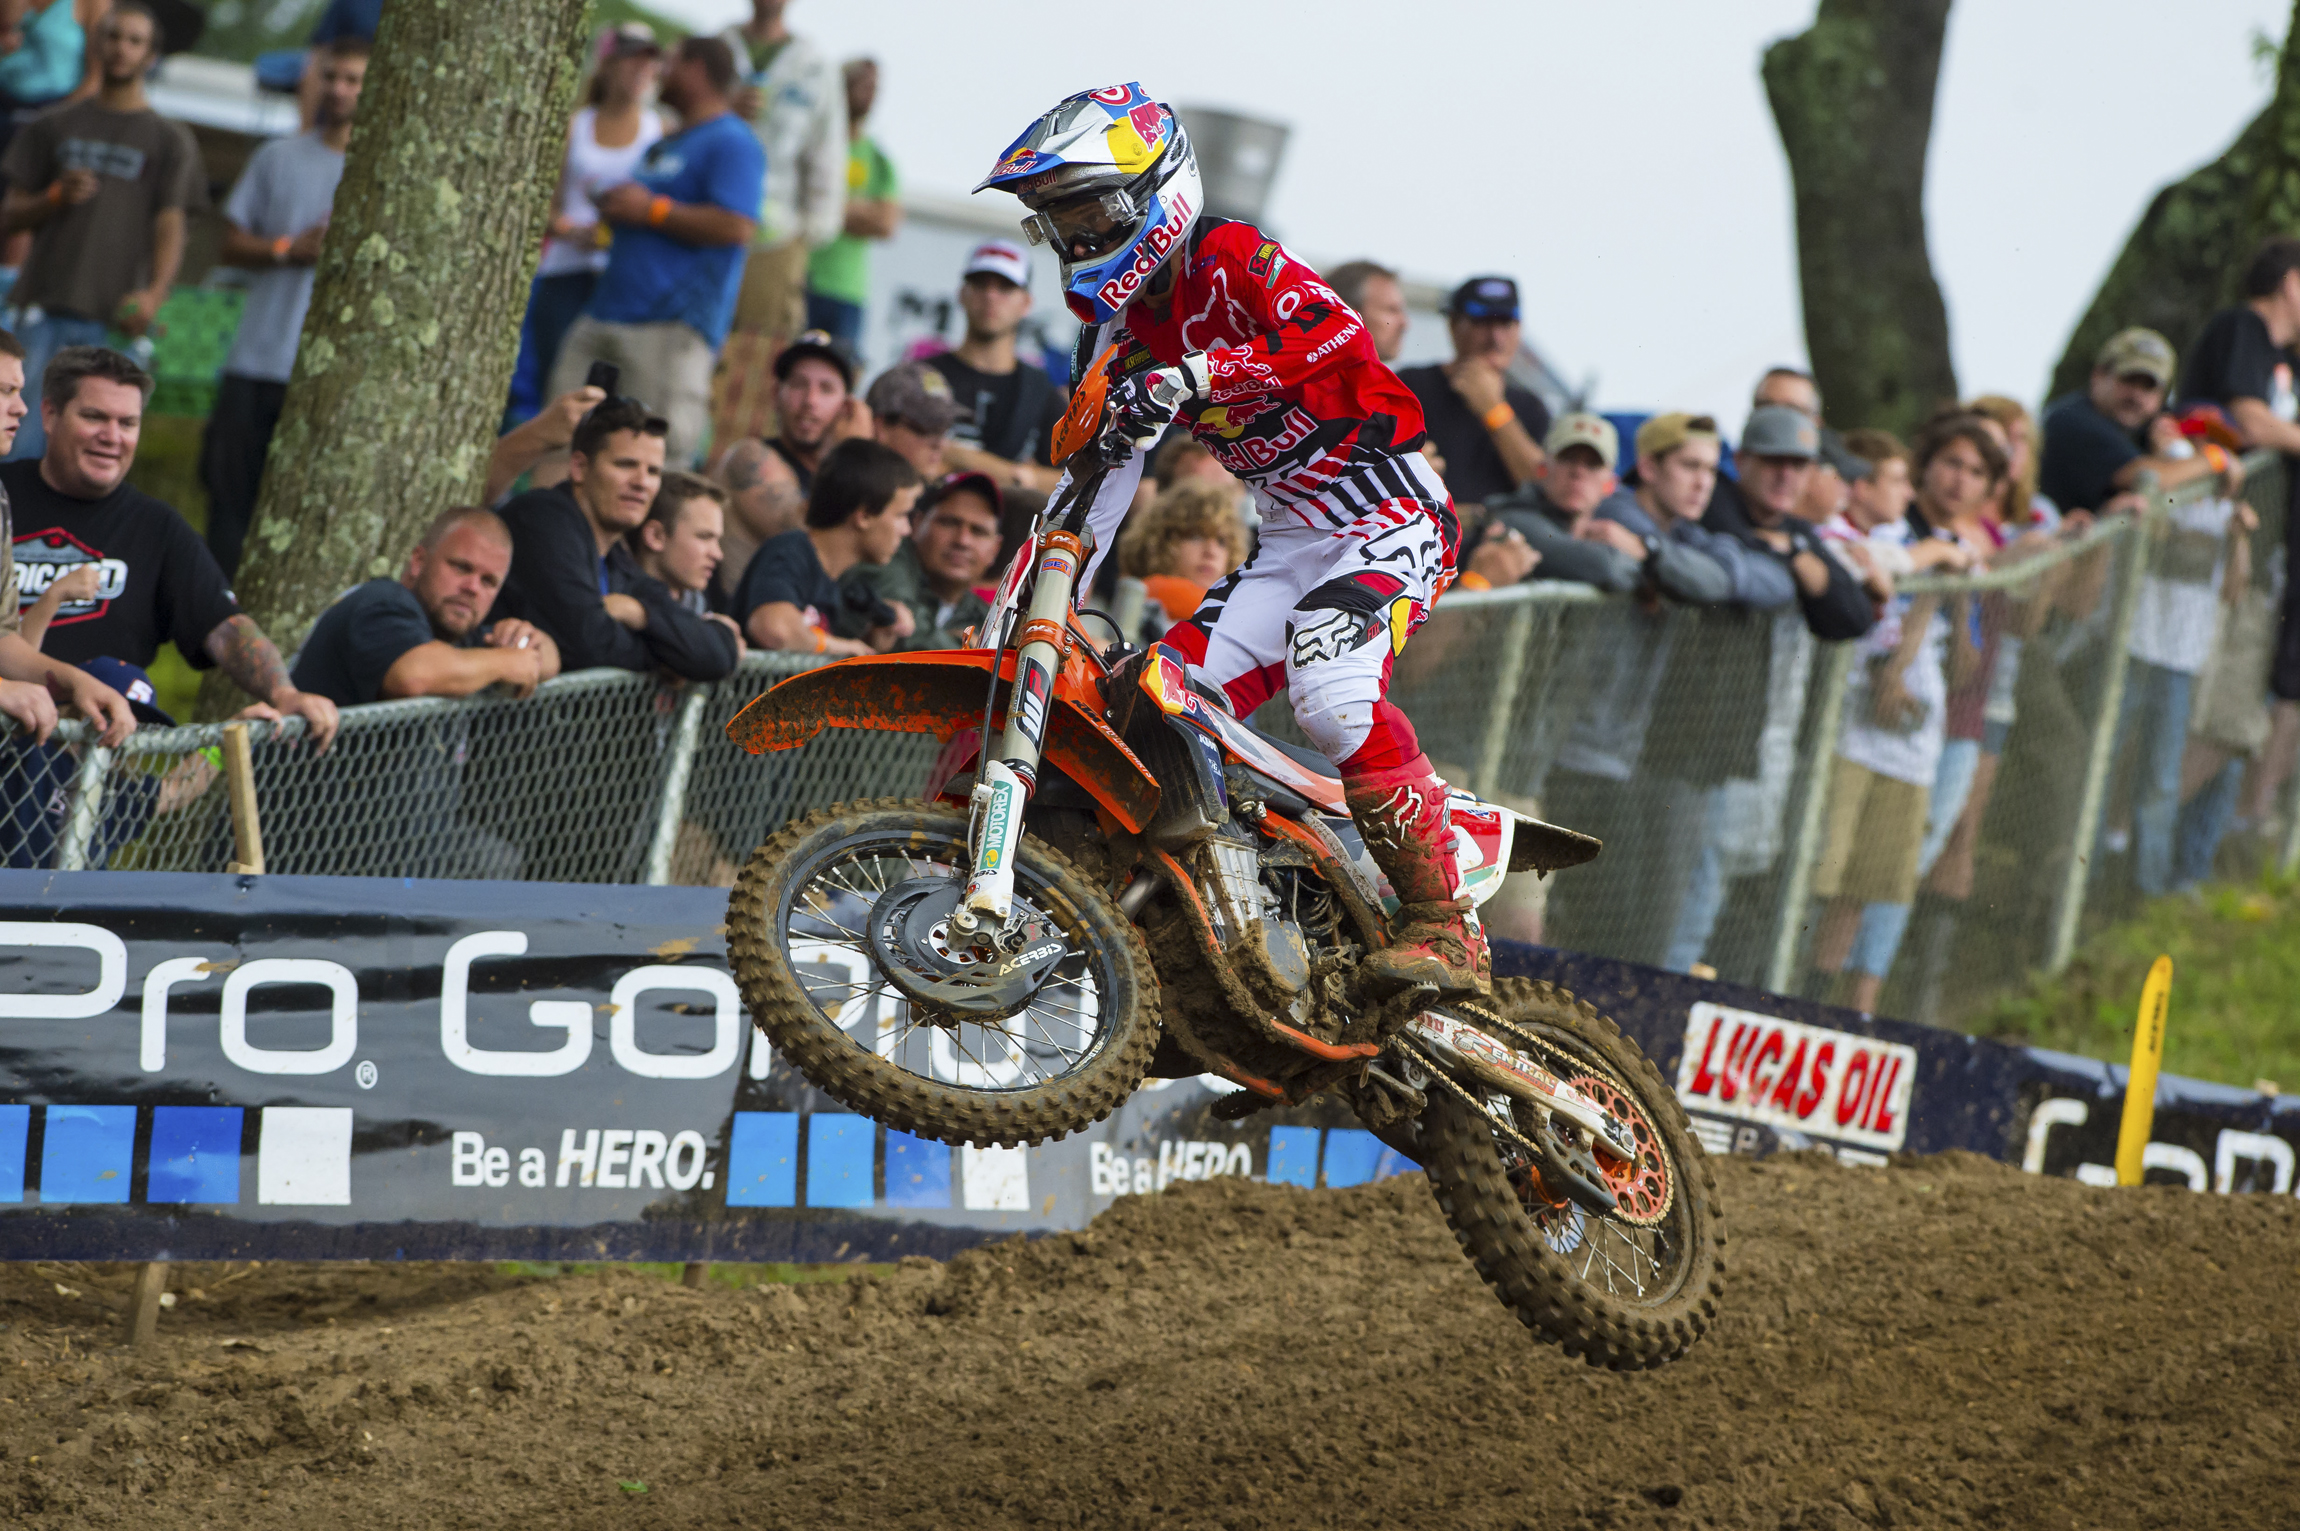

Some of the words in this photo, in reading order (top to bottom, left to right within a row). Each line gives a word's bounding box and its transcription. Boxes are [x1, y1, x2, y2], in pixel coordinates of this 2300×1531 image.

[1018, 177, 1033, 193] Red
[1034, 168, 1057, 188] Bull
[1097, 242, 1159, 311] Red
[1143, 191, 1193, 259] Bull
[1317, 322, 1360, 357] ATHENA
[1208, 381, 1246, 403] Red
[1243, 375, 1284, 393] Bull
[1240, 405, 1320, 467] Bull
[1043, 560, 1071, 572] GET
[1367, 620, 1381, 642] FOX
[1099, 724, 1153, 779] POWERPARTS
[986, 784, 1011, 849] MOTOREX
[1689, 1017, 1836, 1120] LUCAS
[1835, 1048, 1903, 1133] OIL
[451, 1131, 511, 1188] Be
[519, 1146, 546, 1188] a
[556, 1128, 716, 1191] HERO.
[1089, 1141, 1131, 1196] Be
[1133, 1157, 1153, 1195] a
